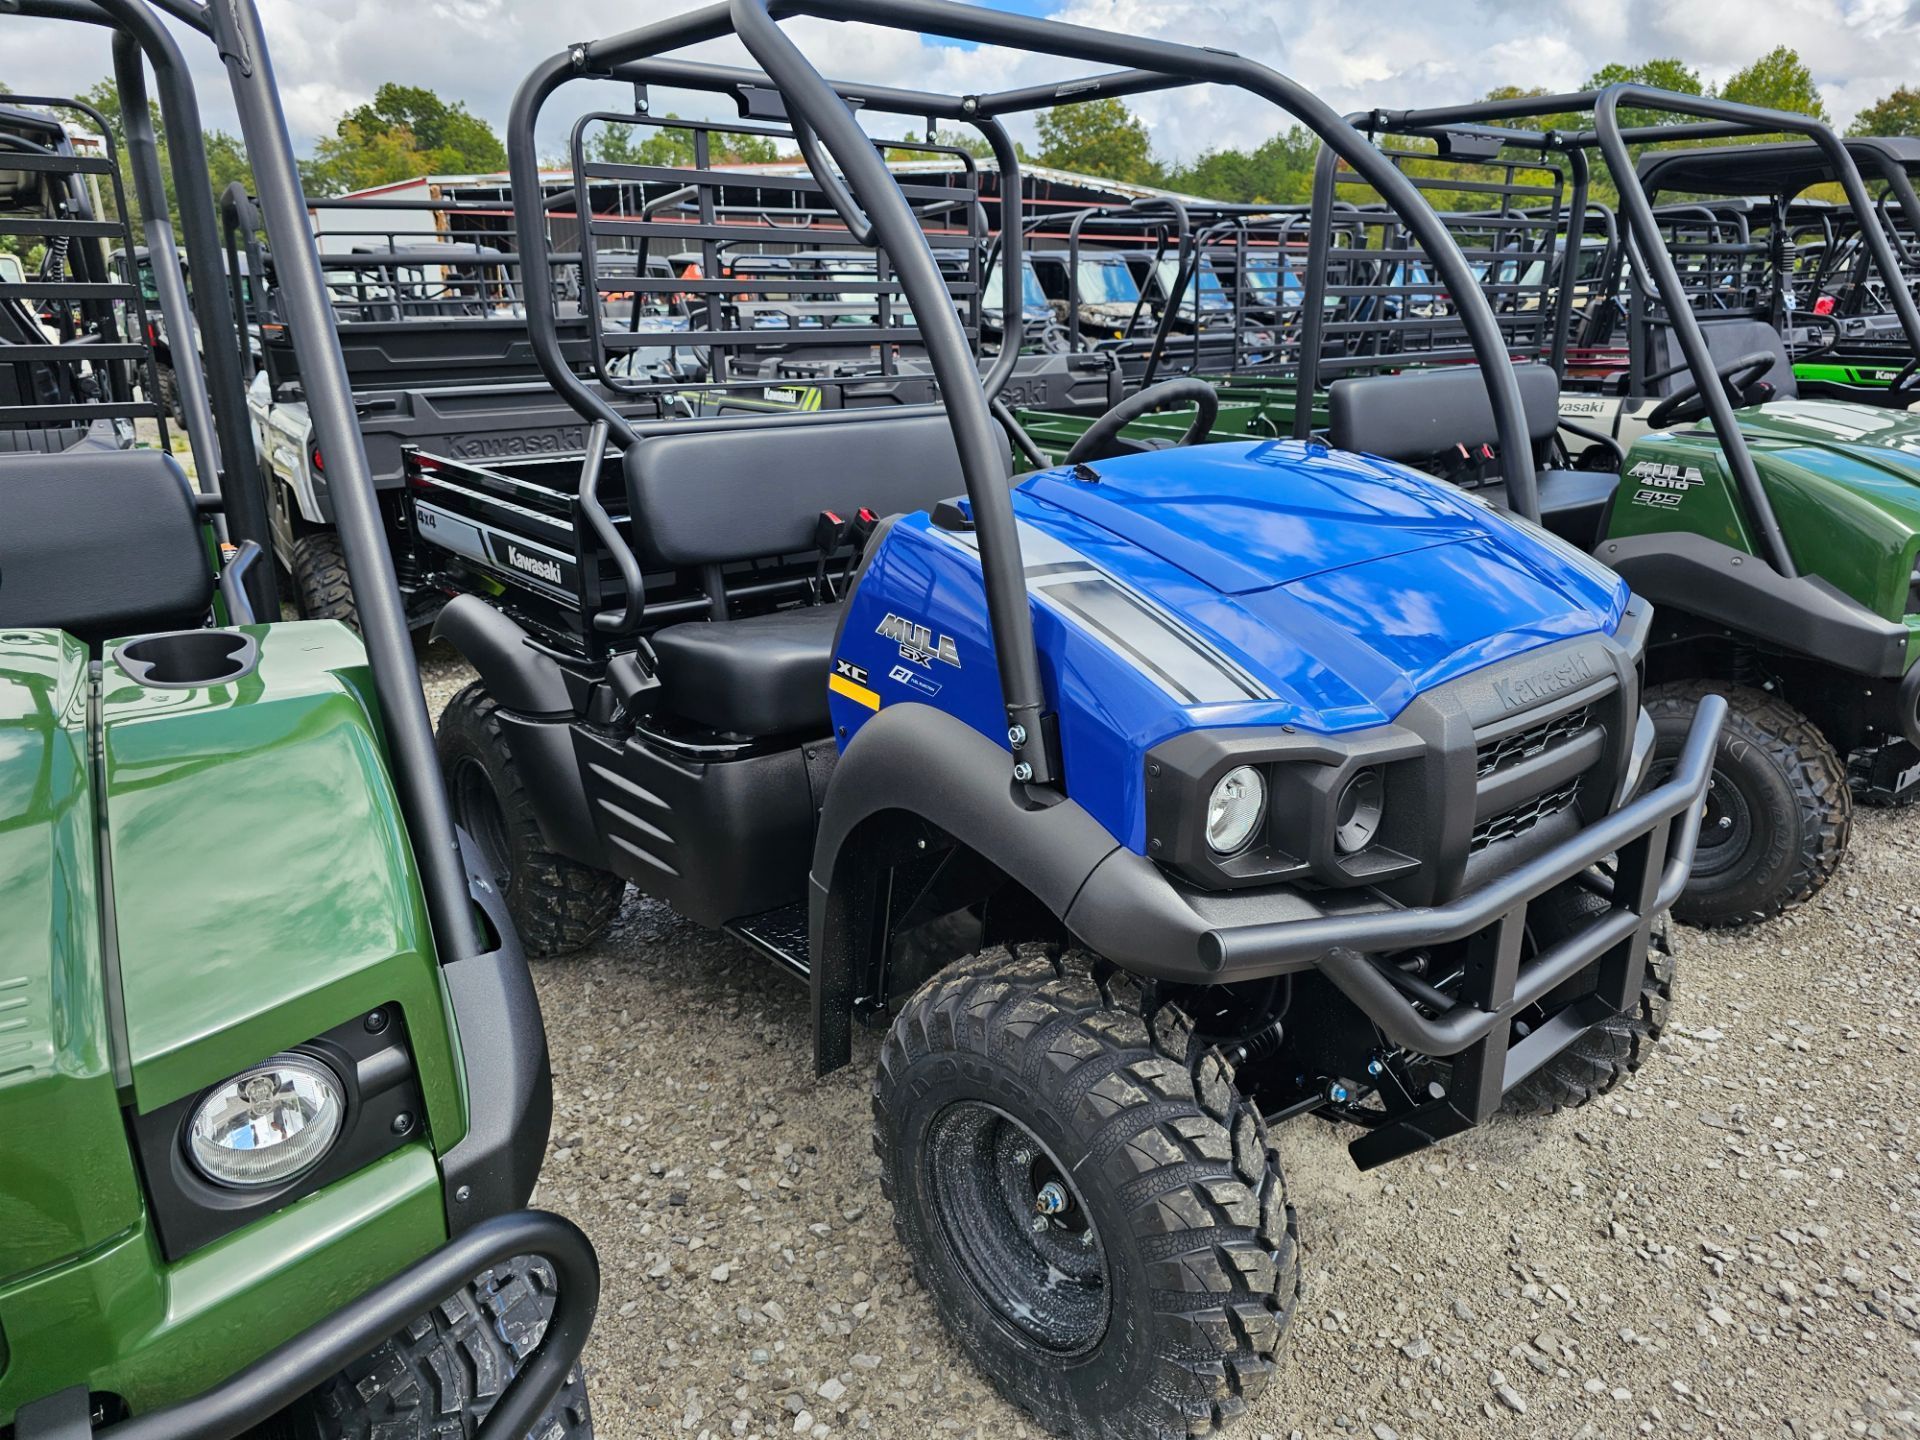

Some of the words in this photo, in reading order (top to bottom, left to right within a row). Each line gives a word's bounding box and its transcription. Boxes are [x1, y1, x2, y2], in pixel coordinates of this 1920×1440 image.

[999, 379, 1048, 407] saki
[1559, 401, 1606, 413] asaki
[443, 427, 584, 459] Kawasaki
[1627, 461, 1706, 486] MULE
[1640, 477, 1690, 491] 4010
[1634, 490, 1683, 505] EPS
[417, 510, 437, 529] 4x4
[507, 545, 562, 584] Kawasaki
[875, 612, 962, 669] MULE
[837, 659, 868, 685] XC
[1492, 652, 1593, 711] Kawasaki
